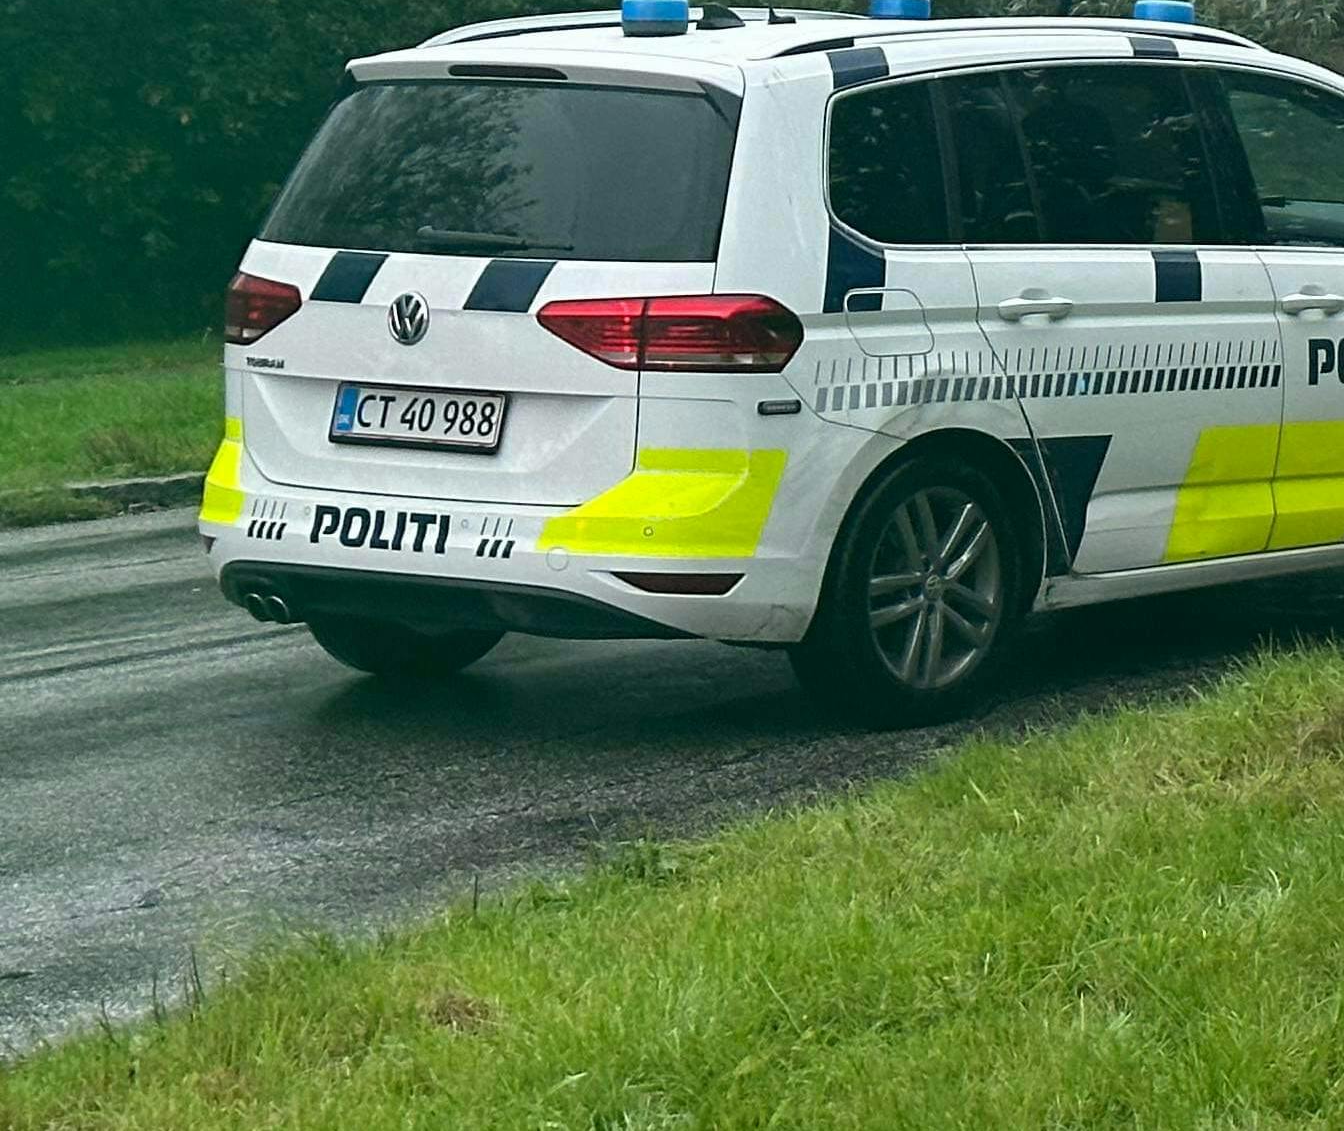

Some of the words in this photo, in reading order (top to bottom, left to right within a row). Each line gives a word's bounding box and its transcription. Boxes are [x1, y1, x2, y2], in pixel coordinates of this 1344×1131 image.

[356, 395, 397, 429] CT
[400, 397, 436, 432] 40
[444, 400, 497, 437] 988
[309, 503, 451, 555] POLITI
